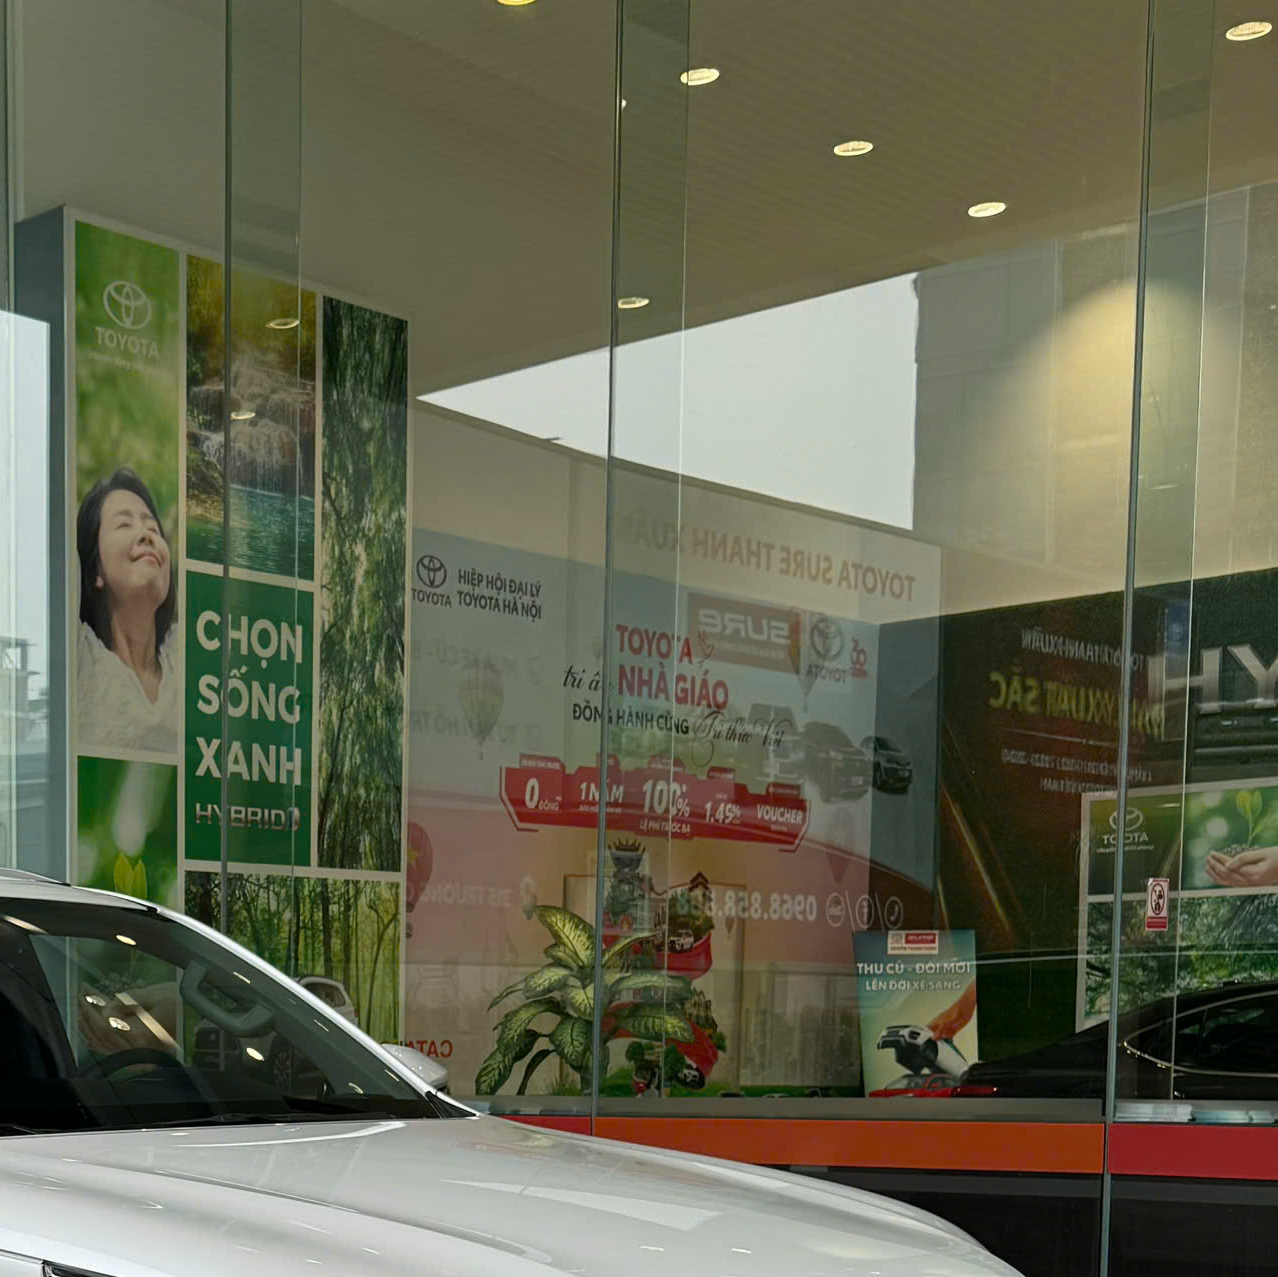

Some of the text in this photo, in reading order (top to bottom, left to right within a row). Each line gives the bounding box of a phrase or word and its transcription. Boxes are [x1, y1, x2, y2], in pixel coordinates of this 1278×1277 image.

[95, 326, 159, 359] TOYOTA
[411, 588, 452, 608] TOYOTA
[458, 568, 541, 600] HIỆP HỘI ĐẠI LÝ
[458, 590, 541, 623] TOYOTA HÀ NỘI
[196, 610, 303, 669] CHỌN
[616, 623, 693, 665] TOYOTA
[197, 665, 301, 724] SỐNG
[618, 662, 729, 711] NHÀ GIÁO
[616, 706, 654, 730] HÀNH
[195, 736, 302, 786] XANH
[525, 777, 539, 809] 0
[757, 804, 802, 824] VOUCHER
[857, 963, 882, 975] THU
[886, 960, 904, 975] CŨ
[928, 979, 961, 991] SANG
